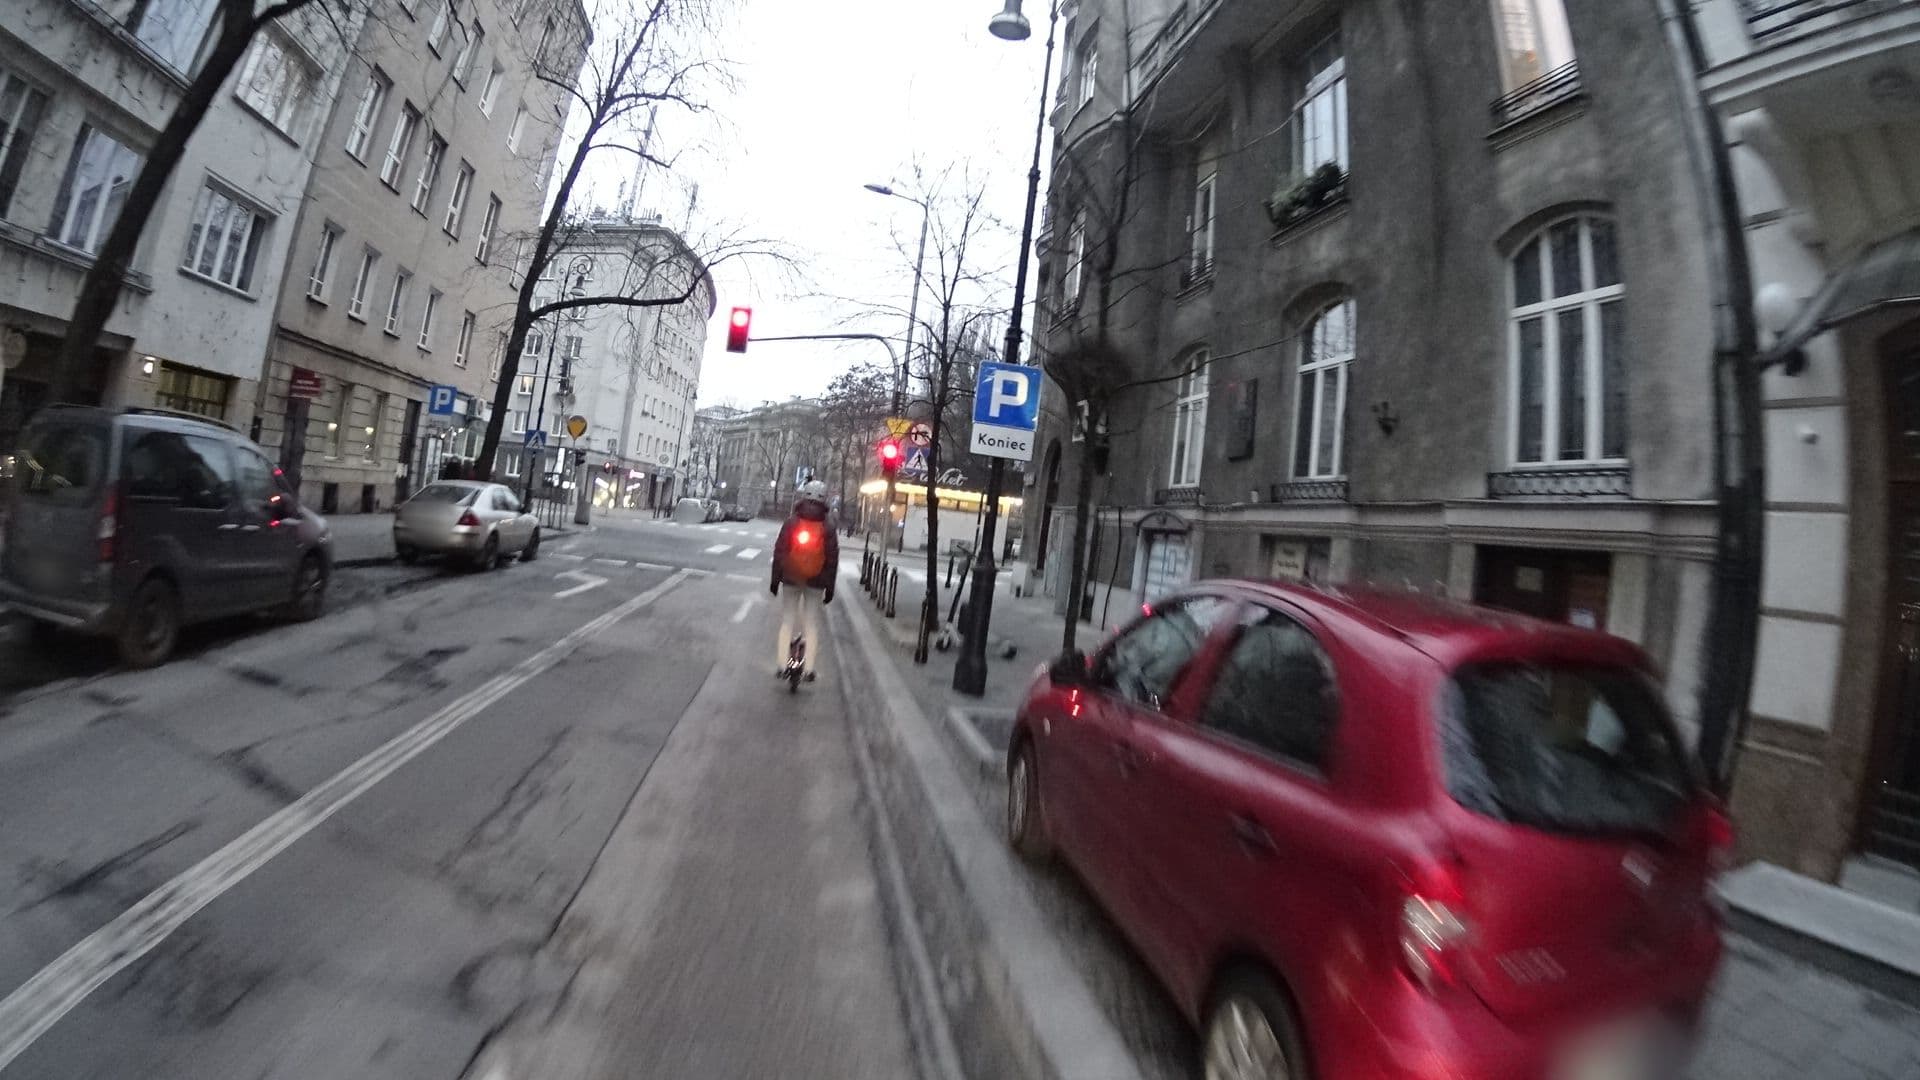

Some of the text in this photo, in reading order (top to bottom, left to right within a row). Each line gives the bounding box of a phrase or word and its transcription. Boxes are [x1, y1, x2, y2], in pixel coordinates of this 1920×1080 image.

[434, 388, 451, 410] P
[989, 370, 1029, 417] P
[978, 433, 1026, 451] Koniec
